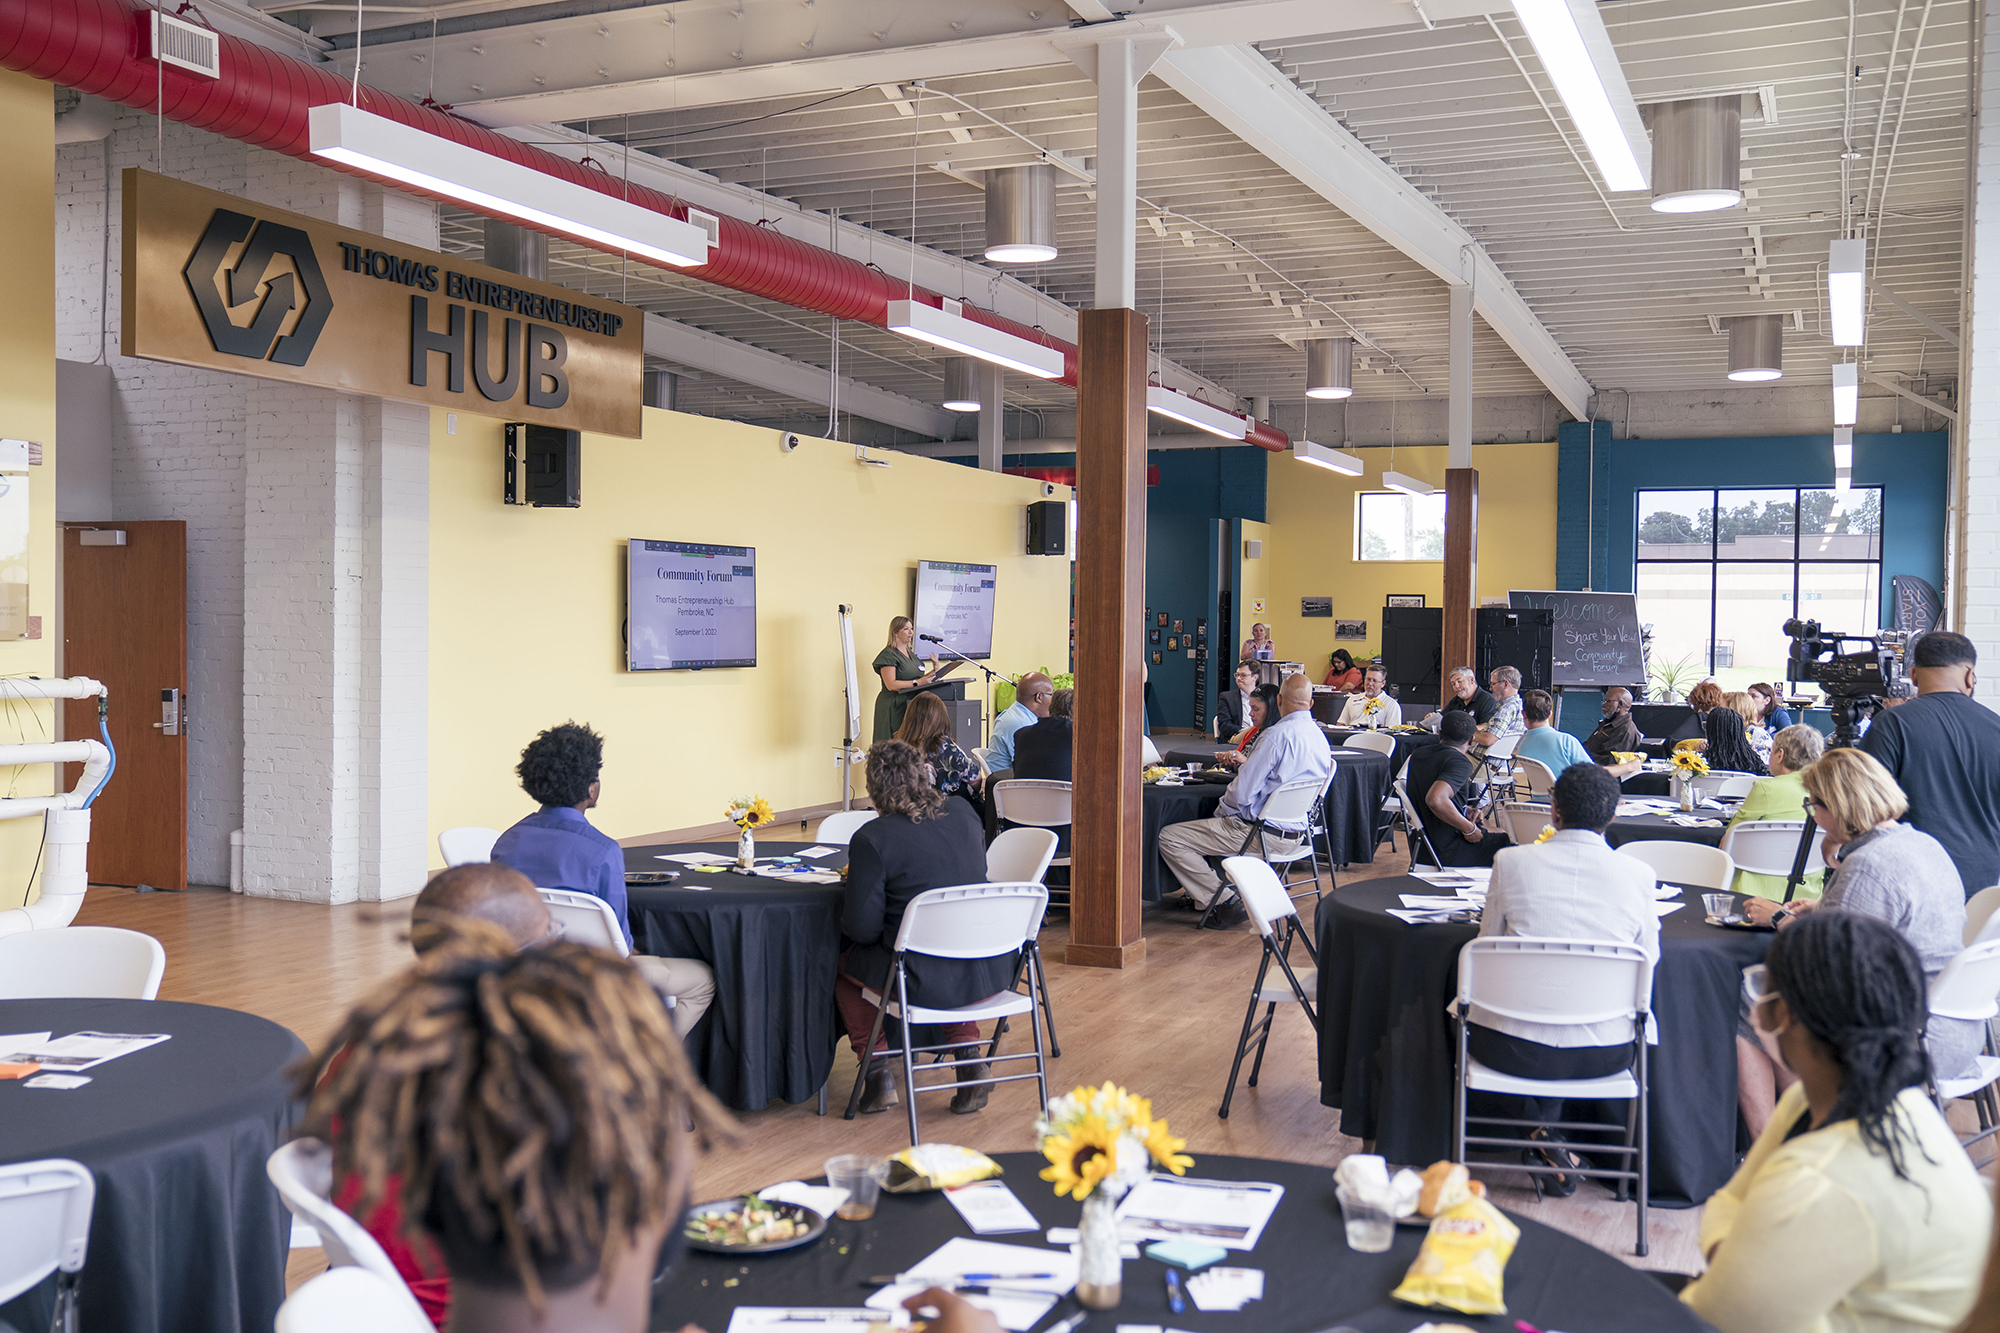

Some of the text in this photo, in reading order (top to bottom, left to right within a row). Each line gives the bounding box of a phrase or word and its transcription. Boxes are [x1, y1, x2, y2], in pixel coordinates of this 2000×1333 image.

[339, 241, 623, 337] THOMAS ENTREPRENEURSHIP
[410, 294, 570, 410] HUB
[657, 567, 733, 585] Community Forum
[655, 595, 735, 606] Thomas Entrepreneurship Hub
[677, 608, 715, 616] Pembroke, NC
[1901, 588, 1913, 631] START
[675, 628, 701, 637] September
[705, 628, 717, 636] 2022
[1562, 622, 1576, 630] the
[1564, 630, 1599, 646] Share
[1599, 628, 1618, 645] Your
[1575, 648, 1626, 664] Community
[1592, 660, 1620, 676] Forum
